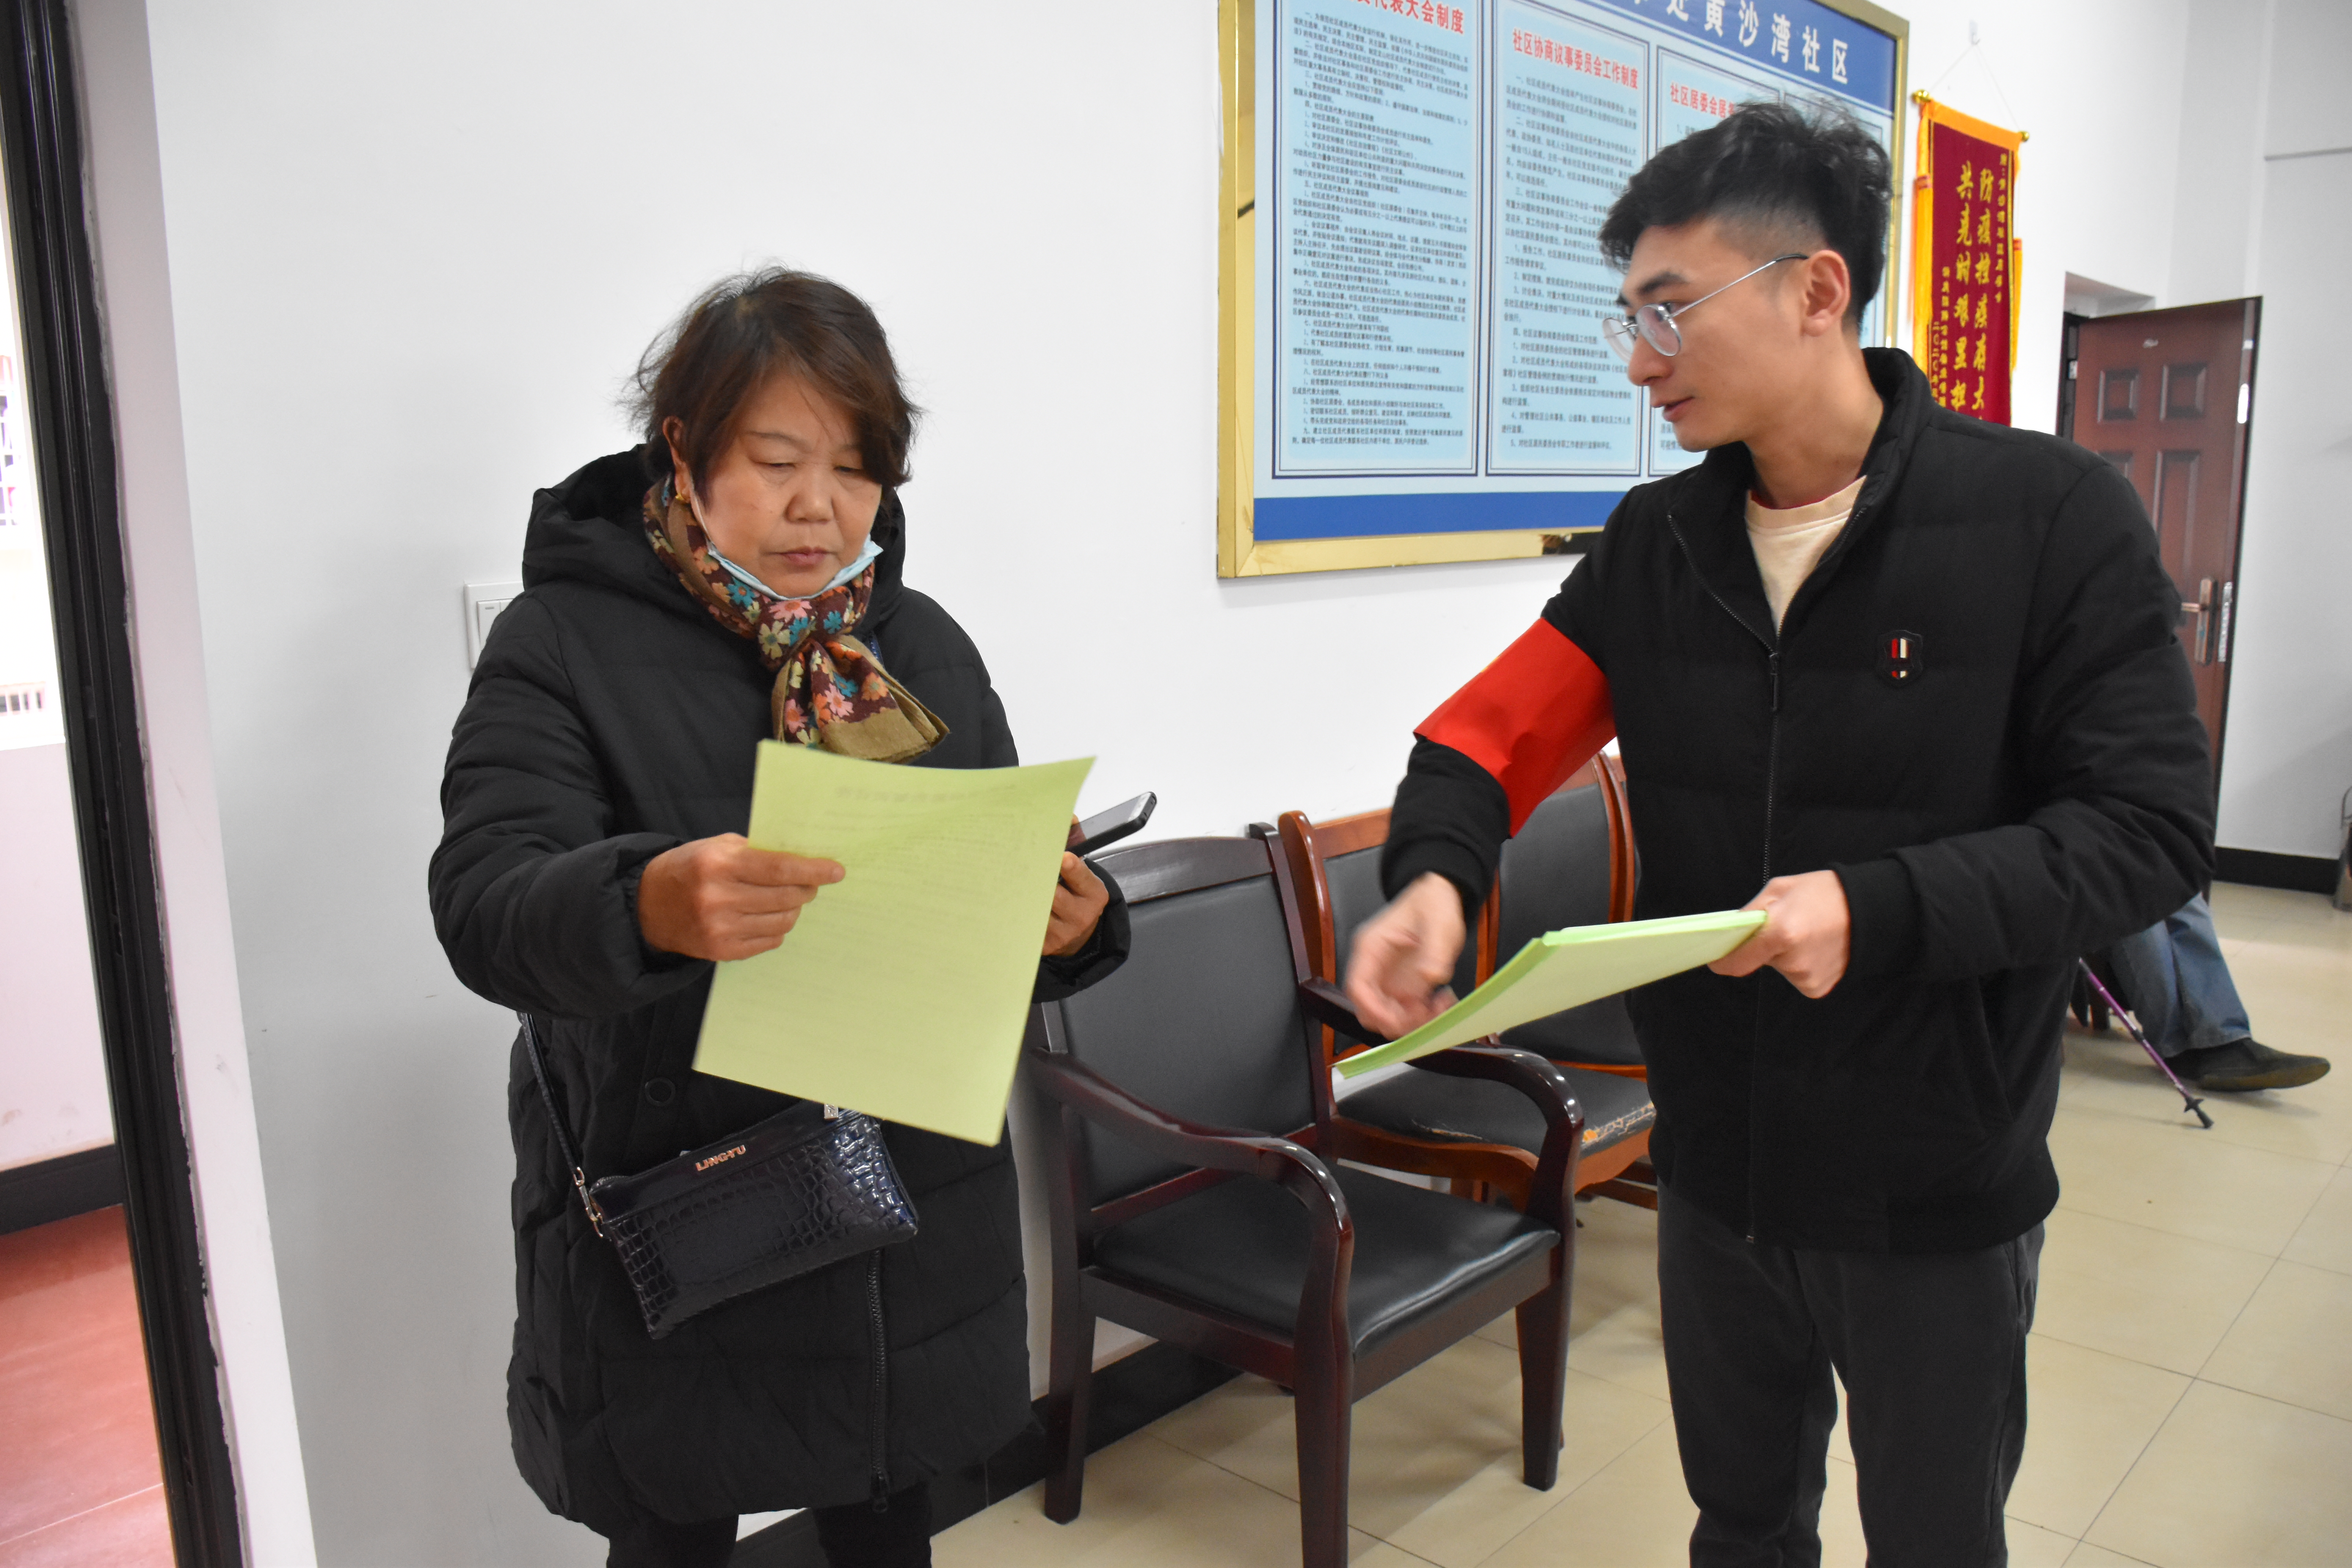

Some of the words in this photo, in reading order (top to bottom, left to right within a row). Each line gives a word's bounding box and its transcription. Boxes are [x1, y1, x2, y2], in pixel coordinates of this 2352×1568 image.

[1357, 0, 1463, 34] 表大会制度
[1634, 0, 1848, 83] 黄沙湾社区
[1512, 27, 1638, 89] 社区协商议事委员会工作制度
